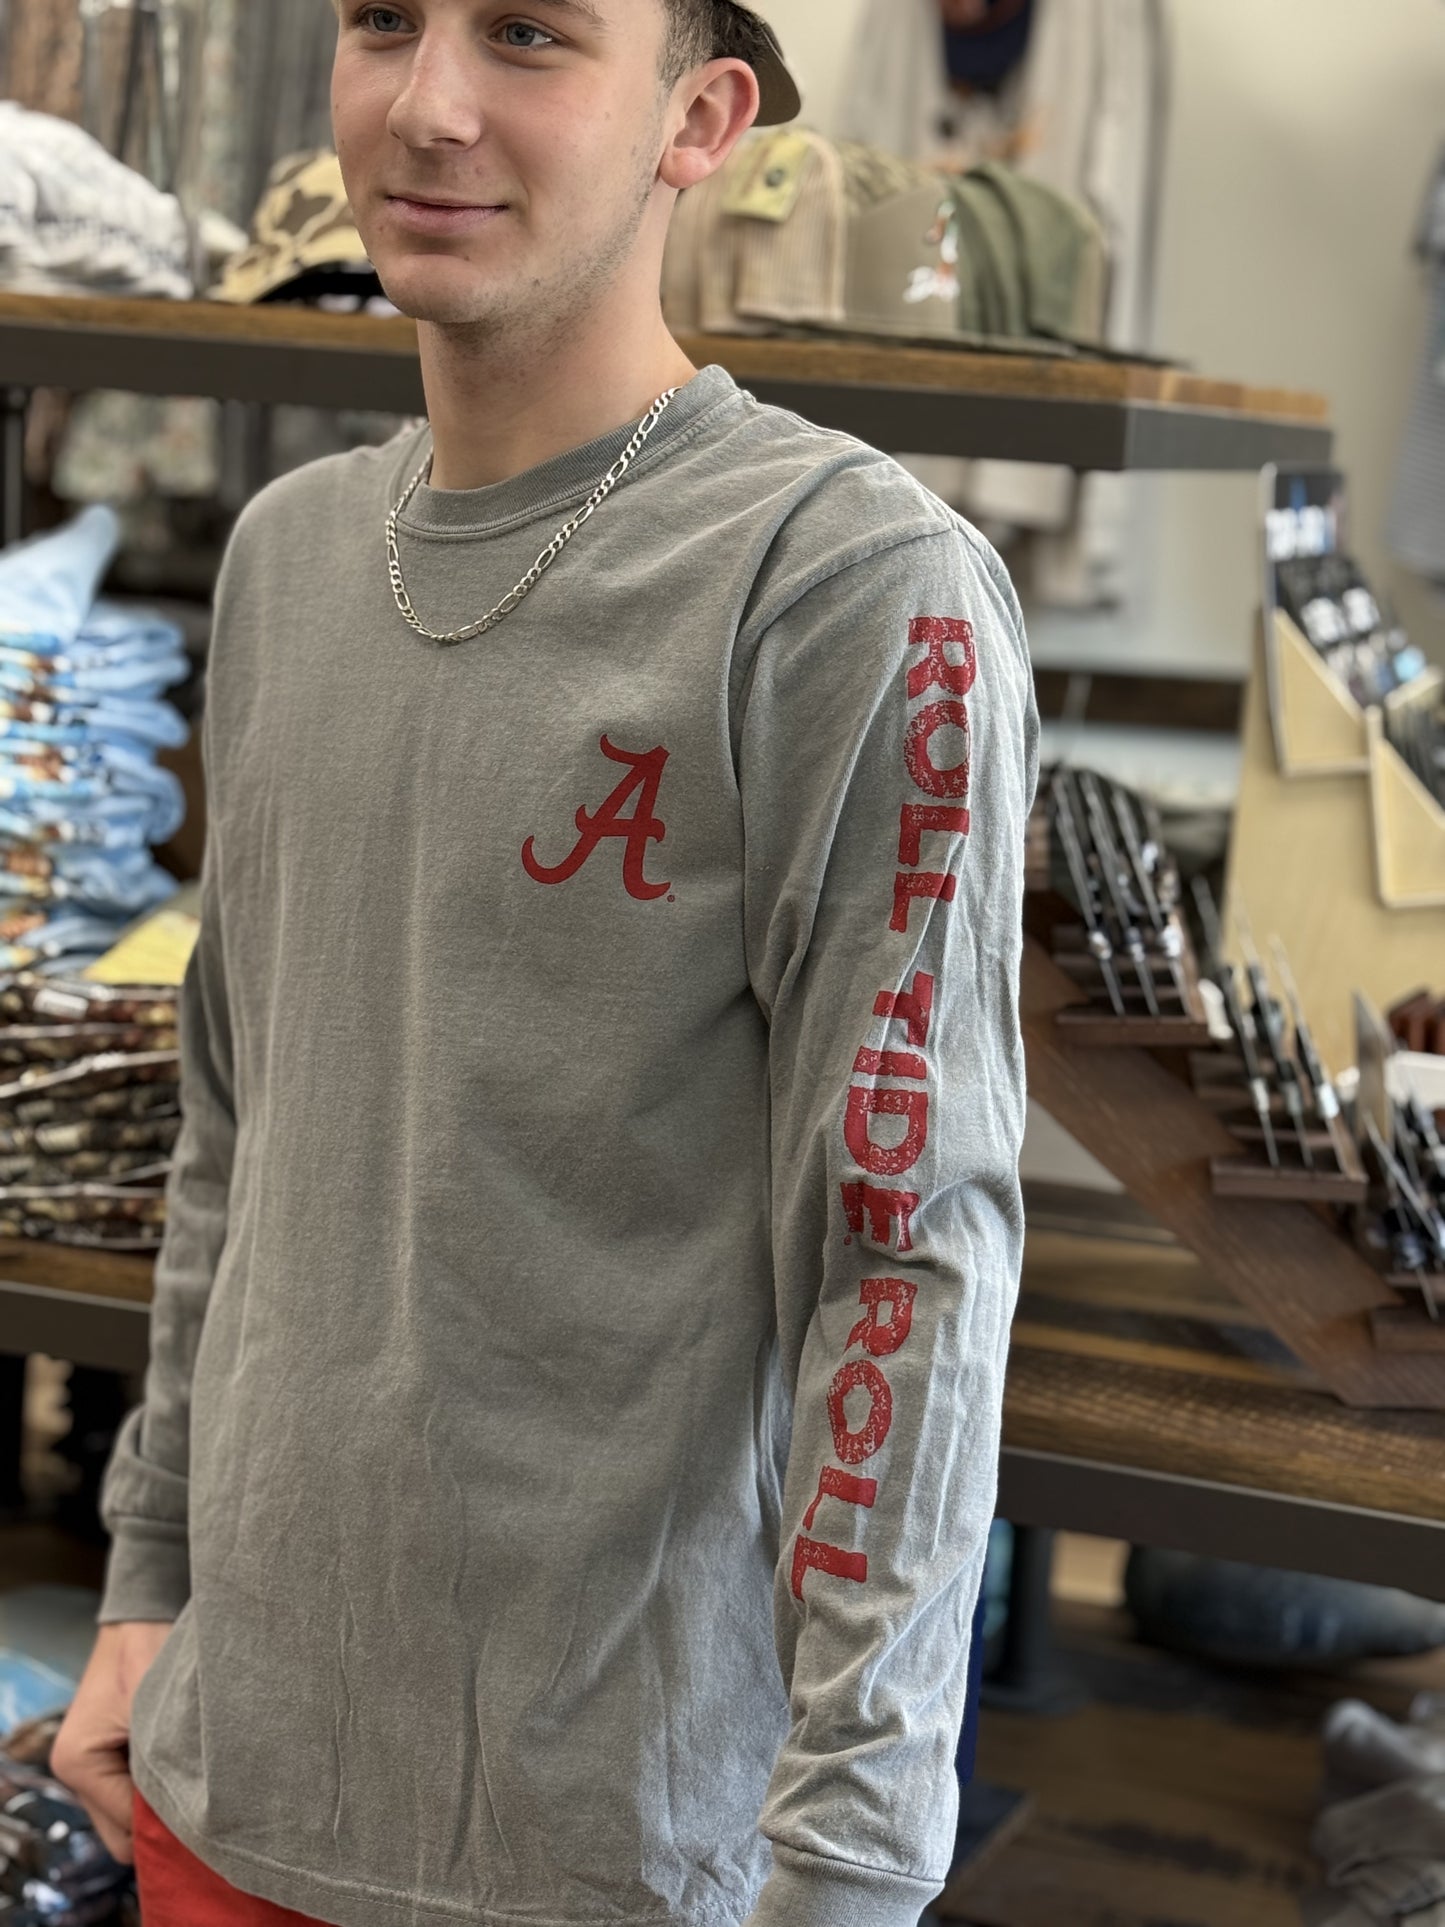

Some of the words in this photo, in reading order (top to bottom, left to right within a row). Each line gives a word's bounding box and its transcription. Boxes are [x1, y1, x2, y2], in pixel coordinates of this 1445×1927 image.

[521, 734, 672, 901] A
[889, 616, 976, 934] ROLL
[840, 970, 934, 1252] TIDE
[790, 1277, 918, 1603] ROLL
